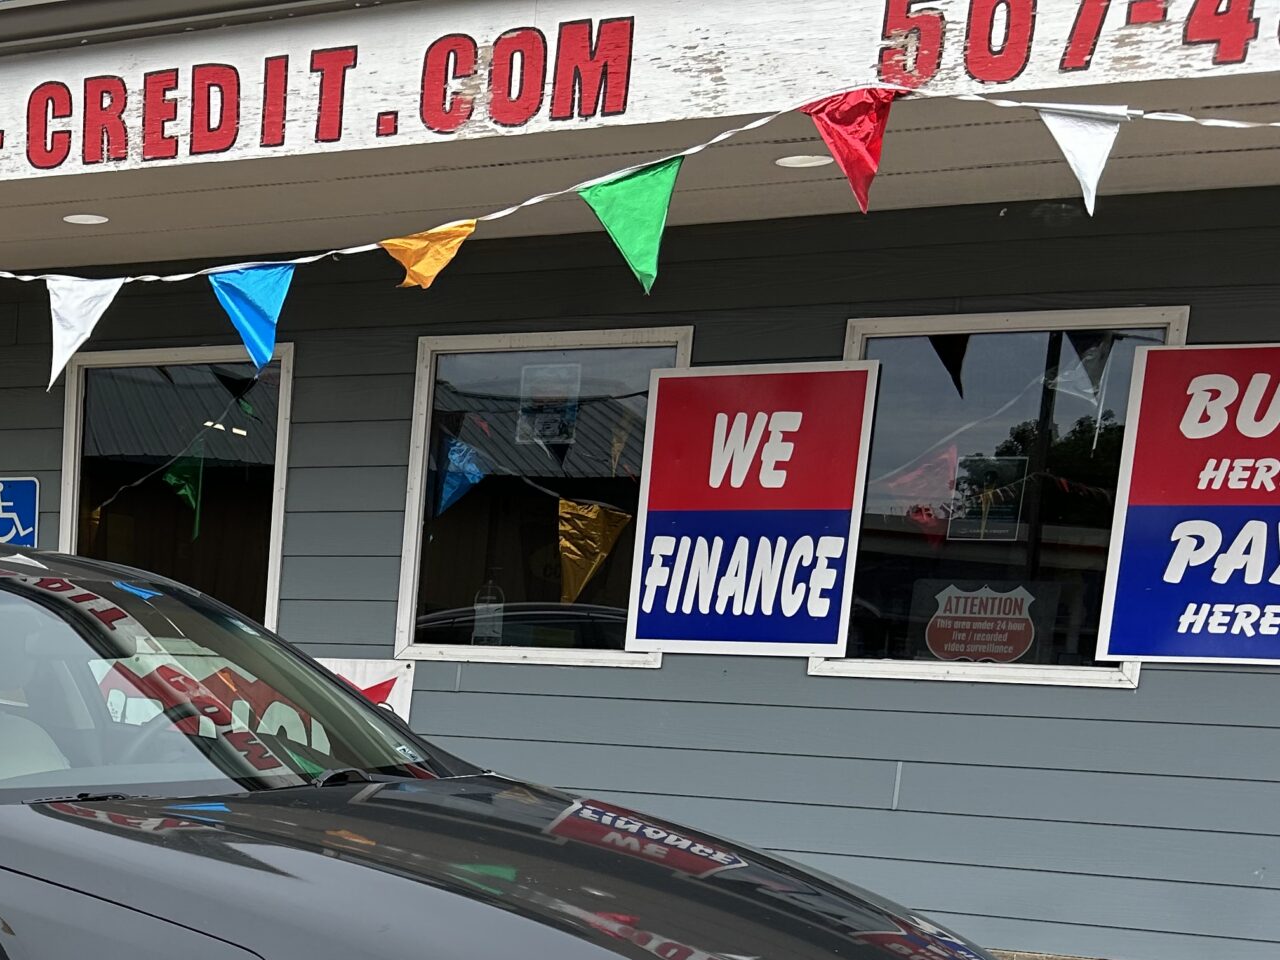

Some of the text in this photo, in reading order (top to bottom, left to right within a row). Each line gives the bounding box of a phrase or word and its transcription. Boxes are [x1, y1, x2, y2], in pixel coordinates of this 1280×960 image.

[876, 0, 1280, 90] 507-4
[708, 410, 804, 489] WE
[1197, 457, 1280, 492] HER
[1163, 519, 1280, 585] PA
[641, 534, 846, 618] FINANCE
[942, 595, 1025, 616] ATTENTION
[936, 619, 1026, 631] This area under 24 hour
[952, 631, 966, 641] live
[973, 631, 1008, 642] recorded
[943, 642, 1014, 654] video surveillance
